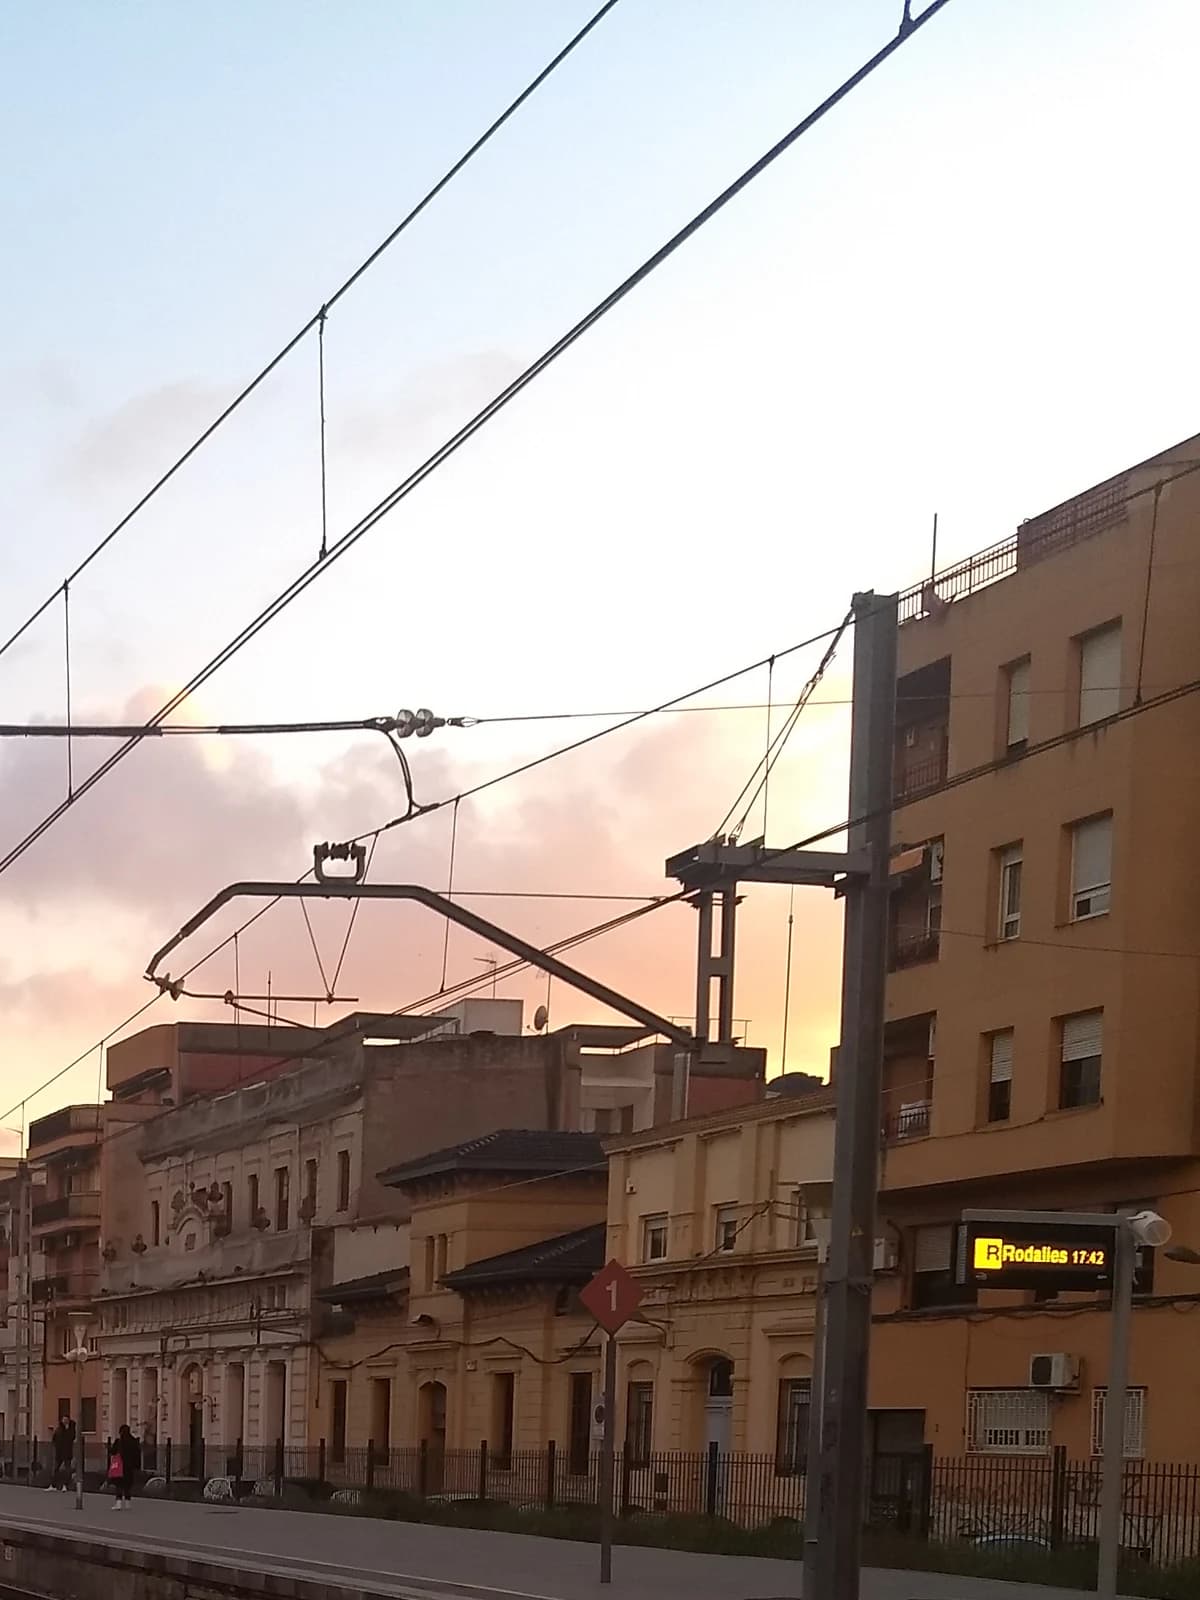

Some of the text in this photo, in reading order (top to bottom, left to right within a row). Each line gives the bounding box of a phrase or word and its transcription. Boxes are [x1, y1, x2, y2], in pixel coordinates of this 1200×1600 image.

[1002, 1244, 1069, 1264] Rodalies
[1072, 1250, 1105, 1265] 17:42
[606, 1280, 618, 1312] 1
